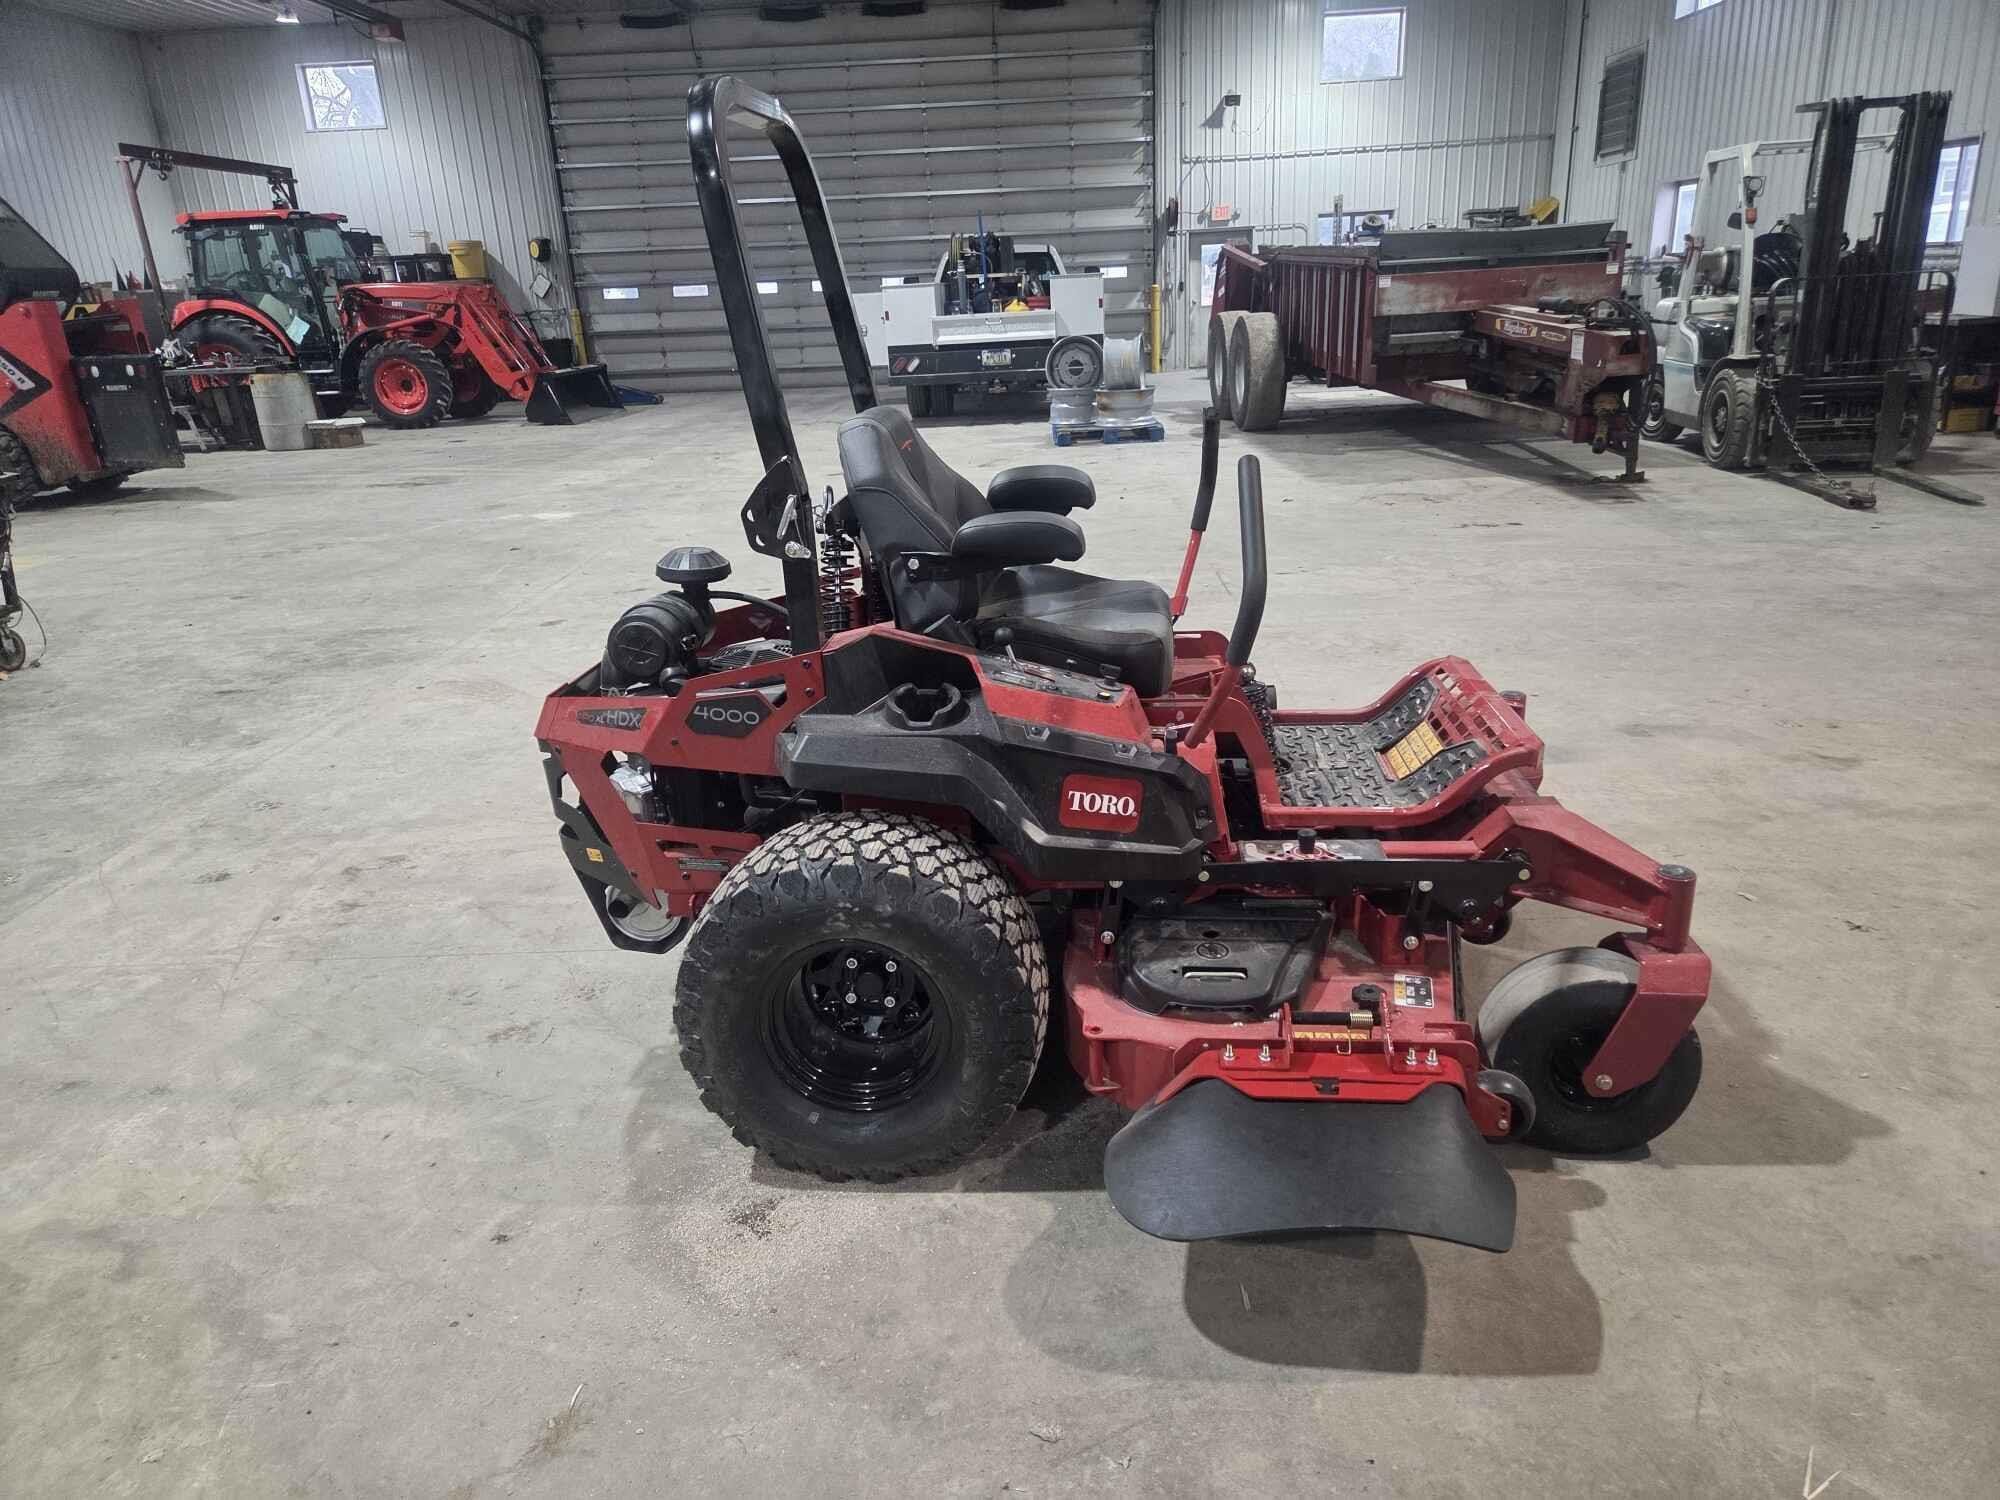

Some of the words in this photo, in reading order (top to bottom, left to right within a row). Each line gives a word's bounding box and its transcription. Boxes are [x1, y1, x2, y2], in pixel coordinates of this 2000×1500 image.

[606, 710, 641, 728] HDX
[693, 705, 760, 725] 4000
[1068, 790, 1137, 816] TORO
